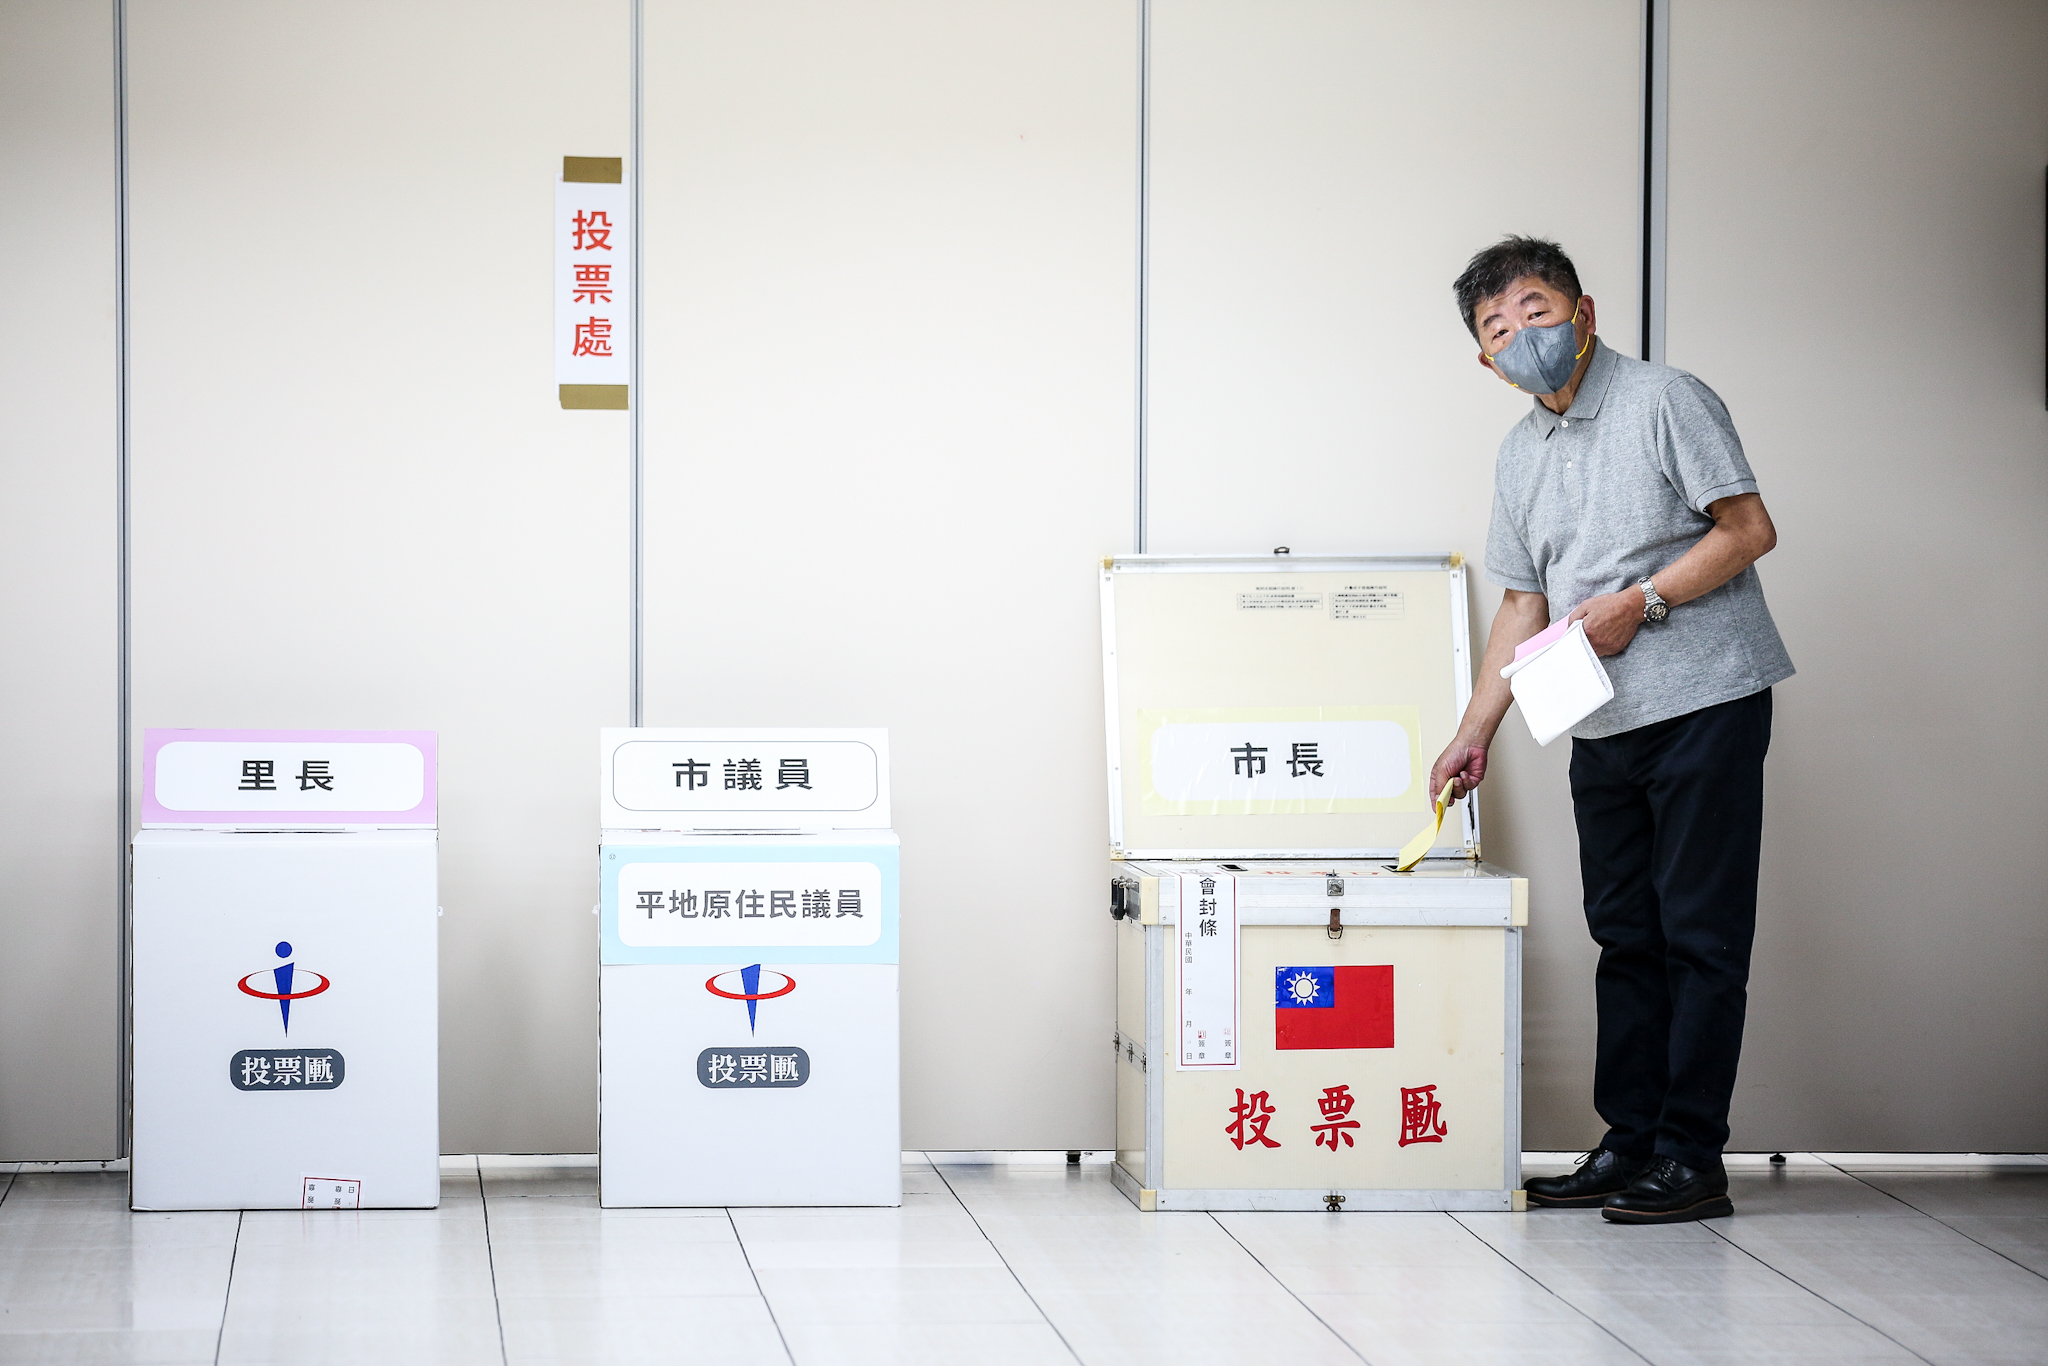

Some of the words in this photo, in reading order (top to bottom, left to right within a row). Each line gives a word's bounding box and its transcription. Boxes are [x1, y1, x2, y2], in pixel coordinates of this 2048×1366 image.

[571, 209, 613, 358] 投票處
[237, 759, 335, 792] 里長
[671, 757, 814, 791] 市議員
[1229, 741, 1325, 779] 市長
[635, 888, 864, 920] 平地原住民議員
[1198, 877, 1218, 937] 會封條
[1184, 931, 1193, 964] 中華民國
[241, 1054, 334, 1086] 投票匭
[707, 1053, 800, 1084] 投票匭
[1224, 1084, 1448, 1152] 投票匭
